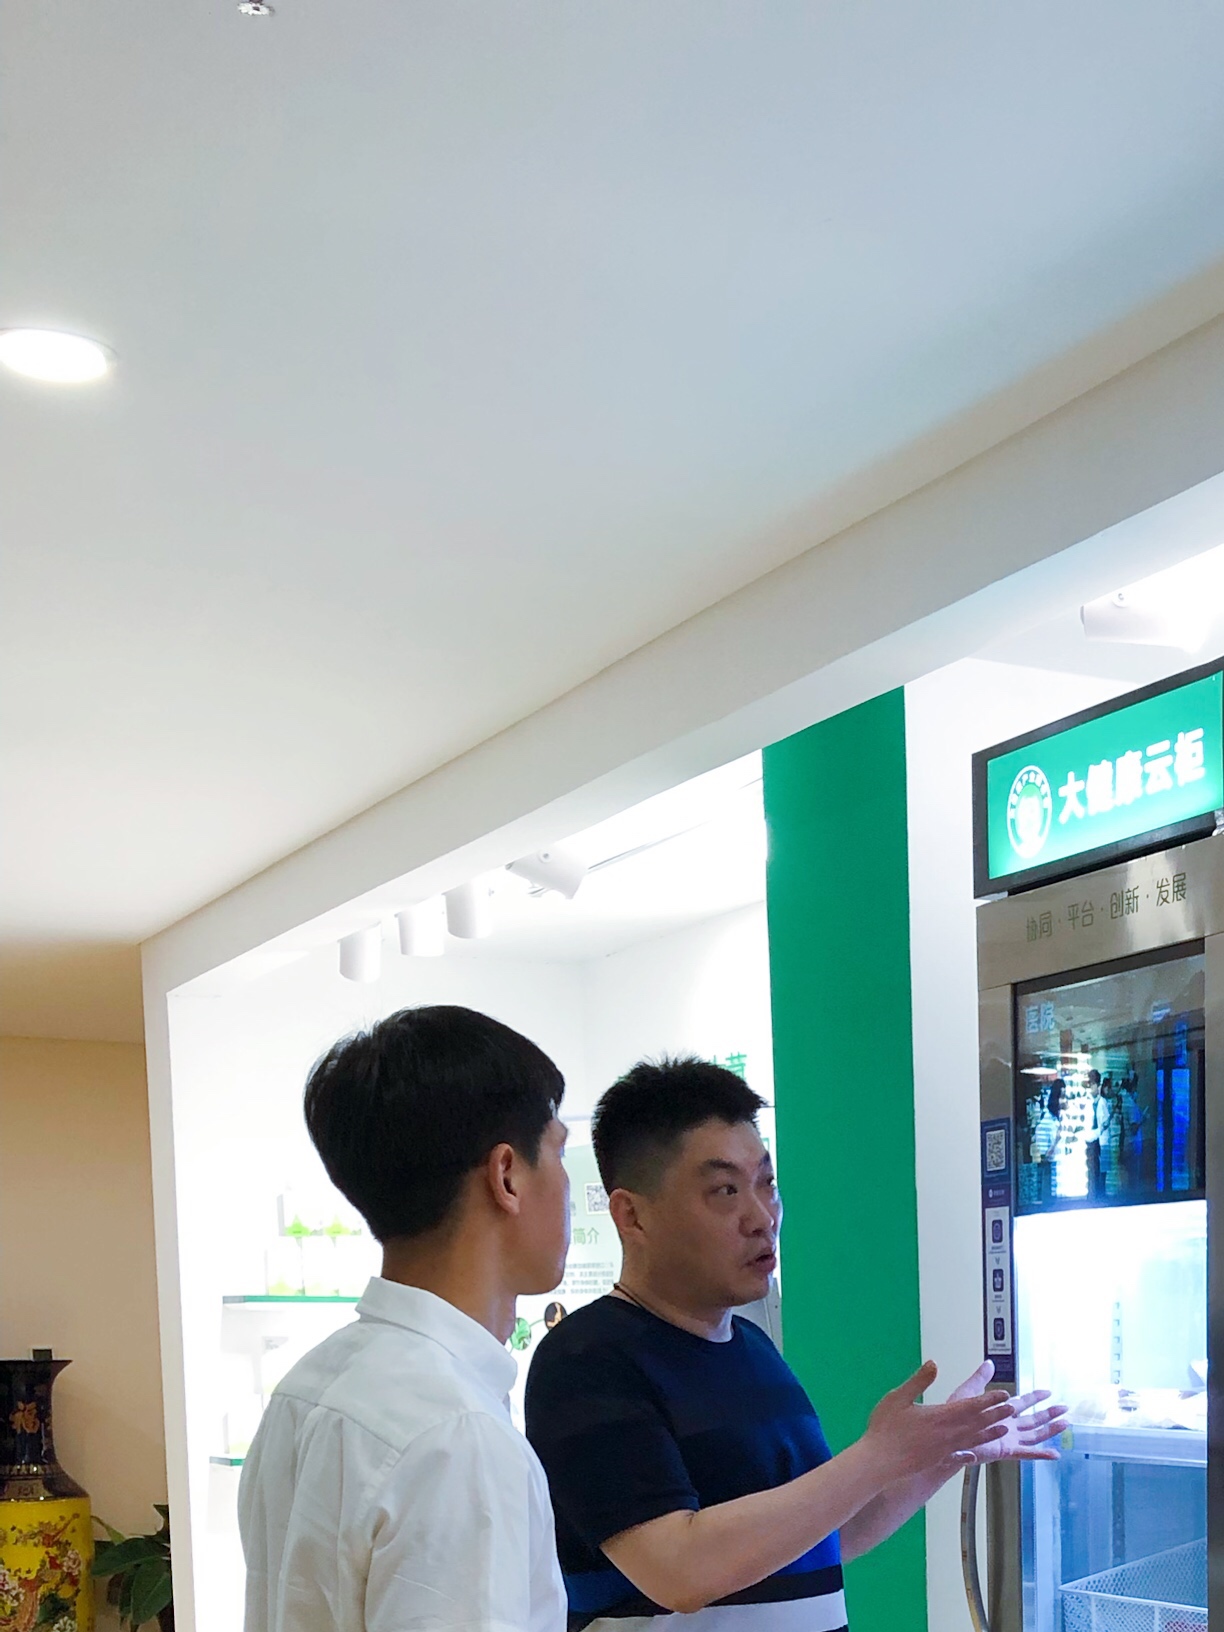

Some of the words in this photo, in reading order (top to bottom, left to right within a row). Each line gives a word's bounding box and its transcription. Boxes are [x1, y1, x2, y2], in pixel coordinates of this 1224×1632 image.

[1058, 727, 1207, 825] 大健康云柜
